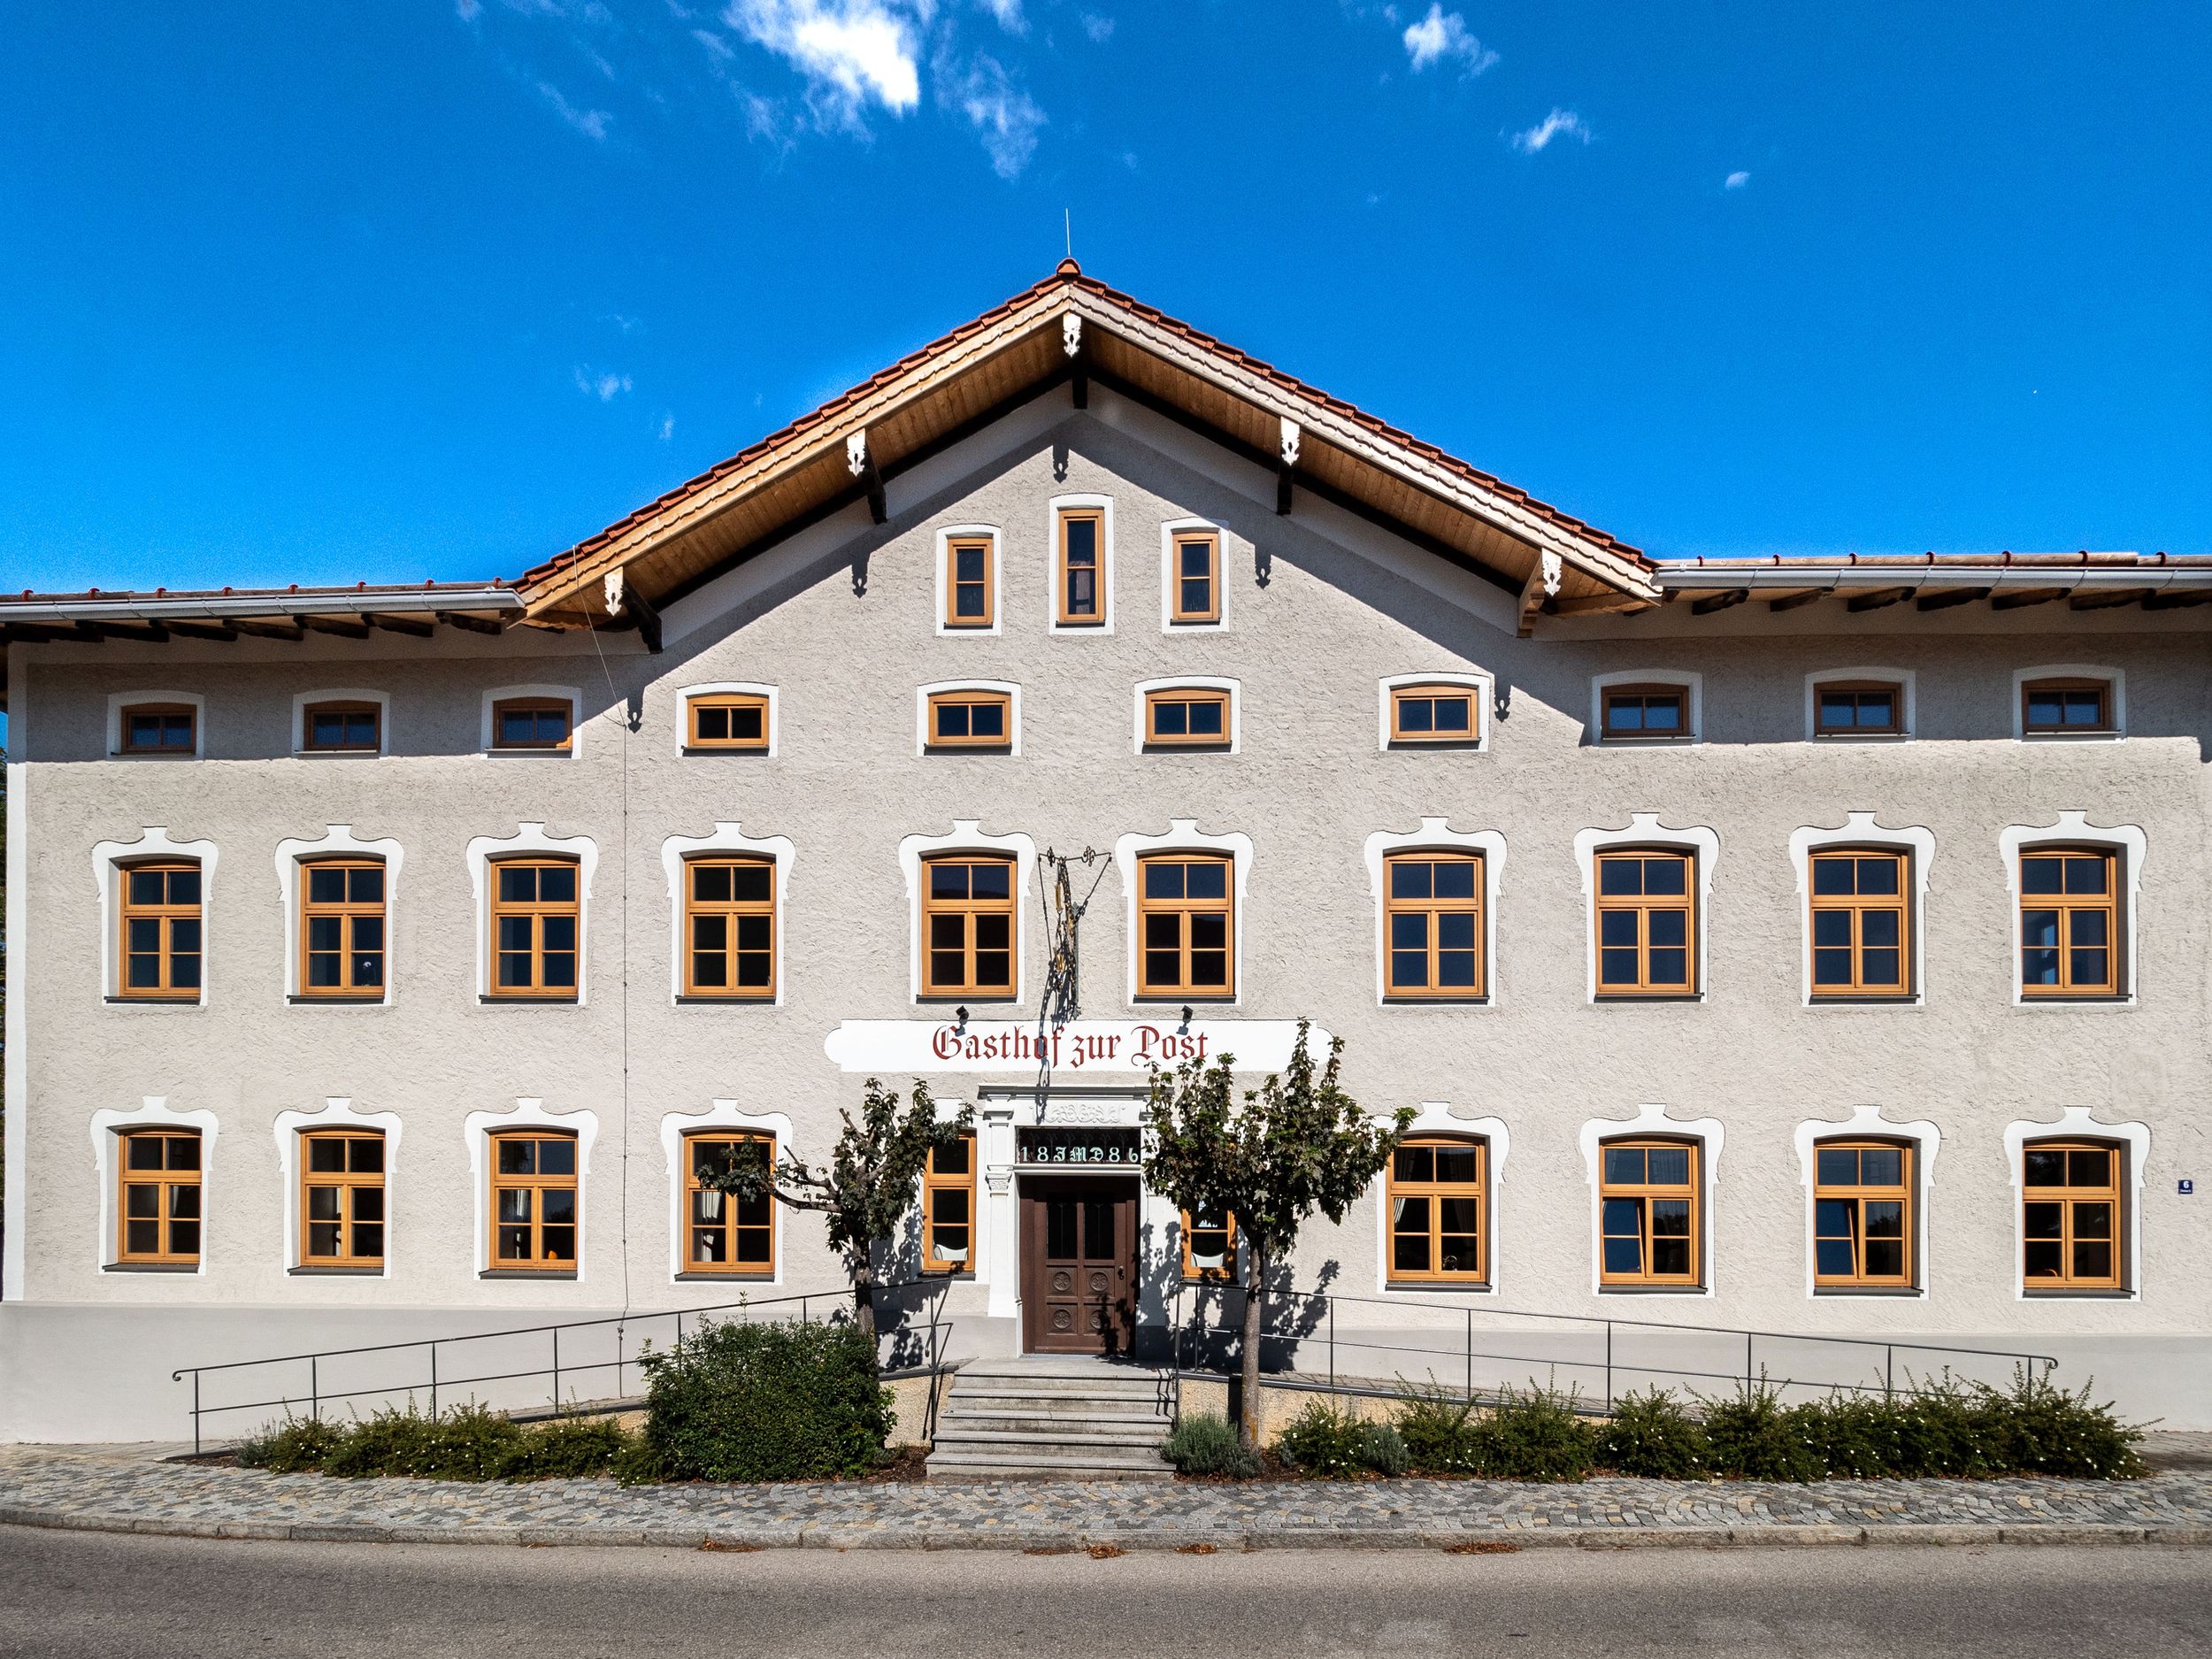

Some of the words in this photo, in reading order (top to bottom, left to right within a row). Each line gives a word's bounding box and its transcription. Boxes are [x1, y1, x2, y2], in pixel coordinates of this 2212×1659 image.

[933, 1025, 1064, 1068] Gasthof
[1070, 1034, 1121, 1068] zur
[1131, 1025, 1209, 1066] Post
[2183, 1180, 2190, 1189] 6
